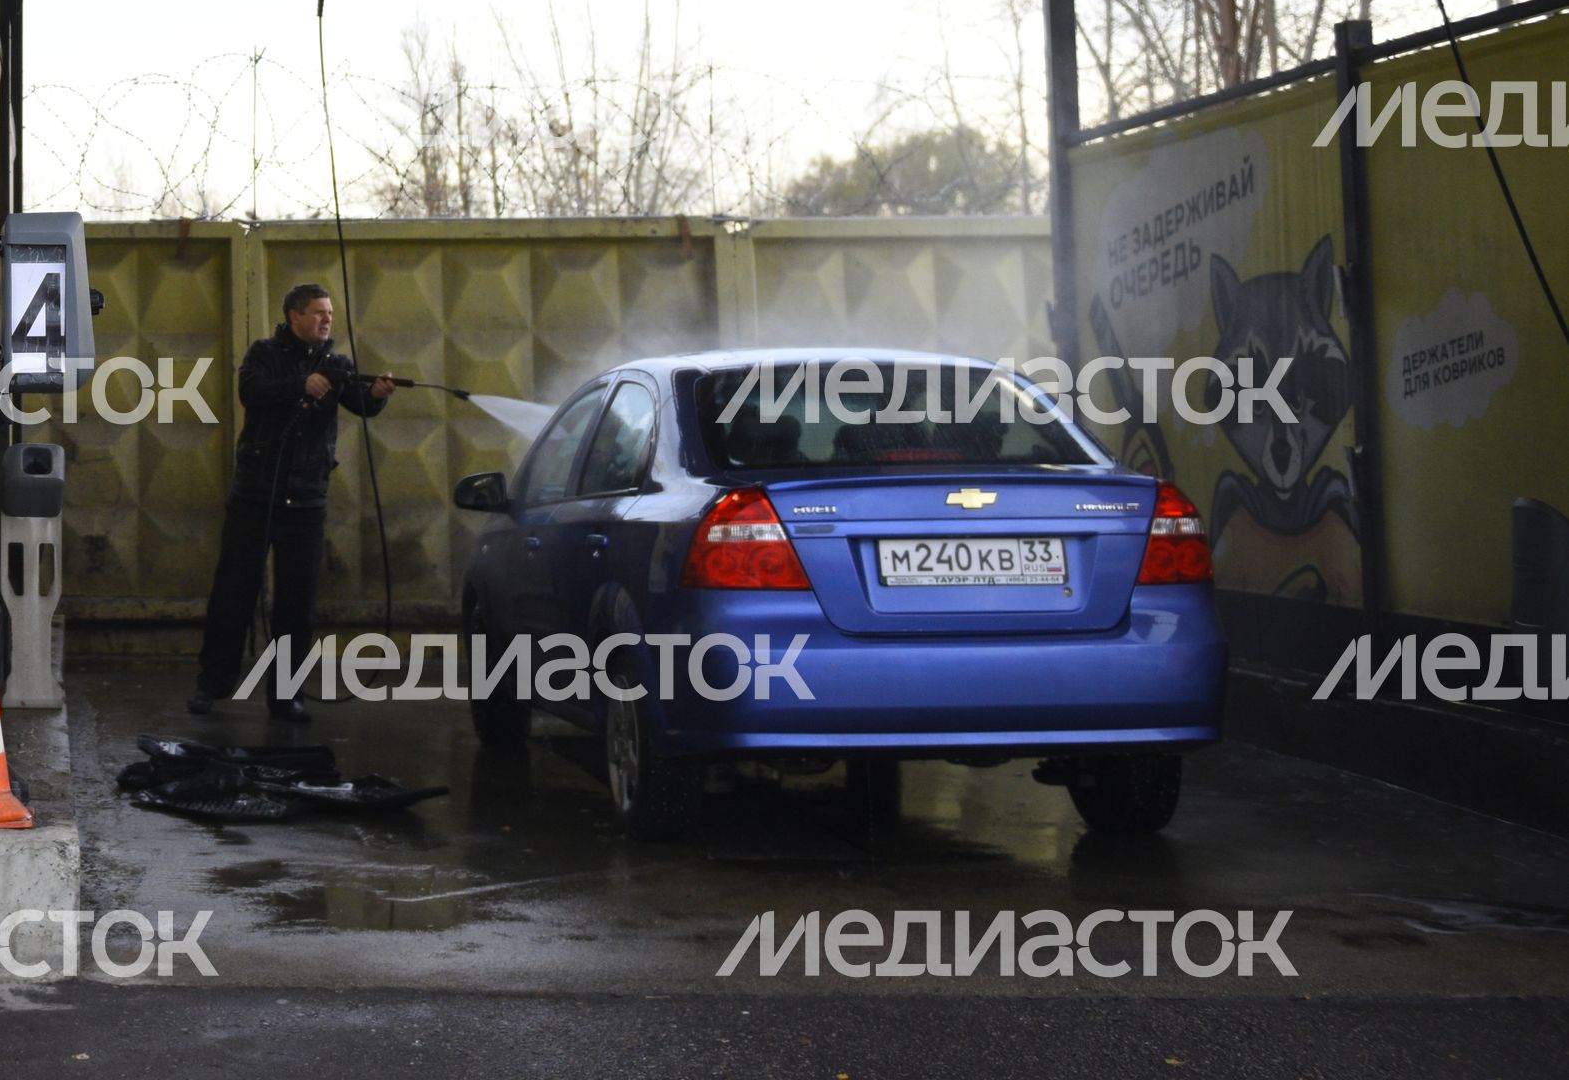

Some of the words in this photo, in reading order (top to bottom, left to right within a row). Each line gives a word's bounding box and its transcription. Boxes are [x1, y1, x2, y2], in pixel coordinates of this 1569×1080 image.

[1107, 233, 1128, 268] НЕ
[1130, 155, 1254, 257] ЗАДЕРЖИВАЙ
[1109, 238, 1202, 310] ОЧЕРЕДЬ
[12, 272, 66, 373] 4
[1401, 330, 1485, 378] ДЕРЖАТЕЛИ
[1403, 370, 1432, 399] ДЛЯ
[1433, 346, 1506, 386] КОВРИКОВ
[890, 542, 1015, 572] М240КВ
[1023, 540, 1053, 562] 33
[1023, 563, 1046, 573] RUS
